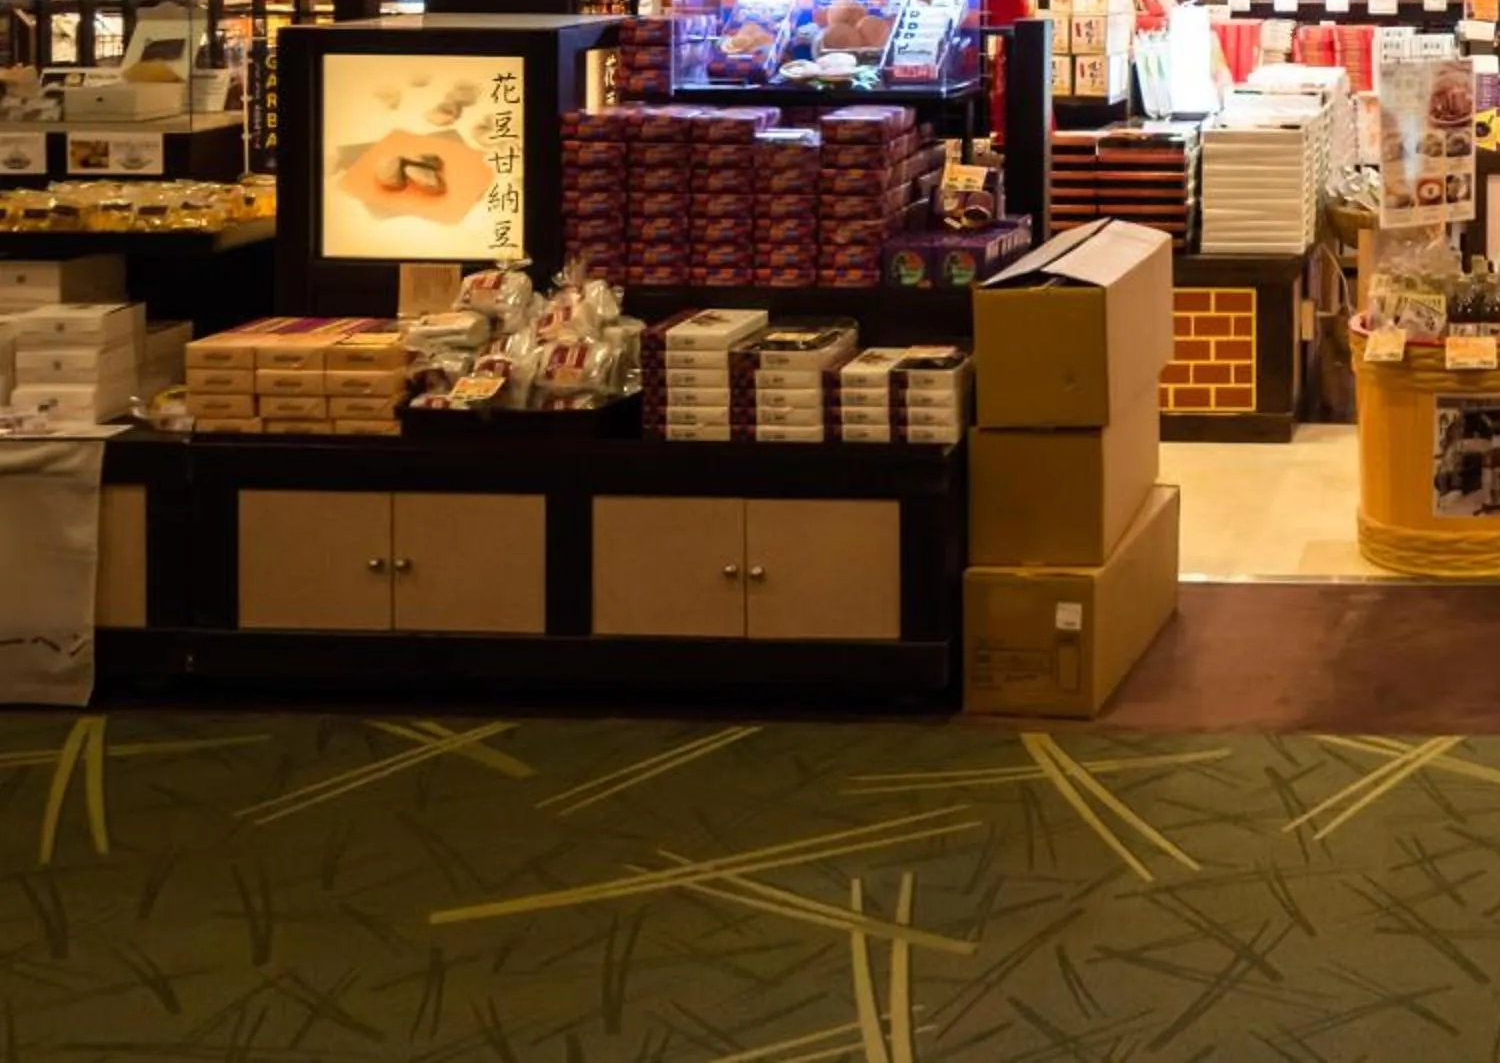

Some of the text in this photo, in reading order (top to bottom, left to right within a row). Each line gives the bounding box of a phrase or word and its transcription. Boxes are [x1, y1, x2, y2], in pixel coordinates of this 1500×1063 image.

[487, 72, 521, 250] 花豆甘納豆
